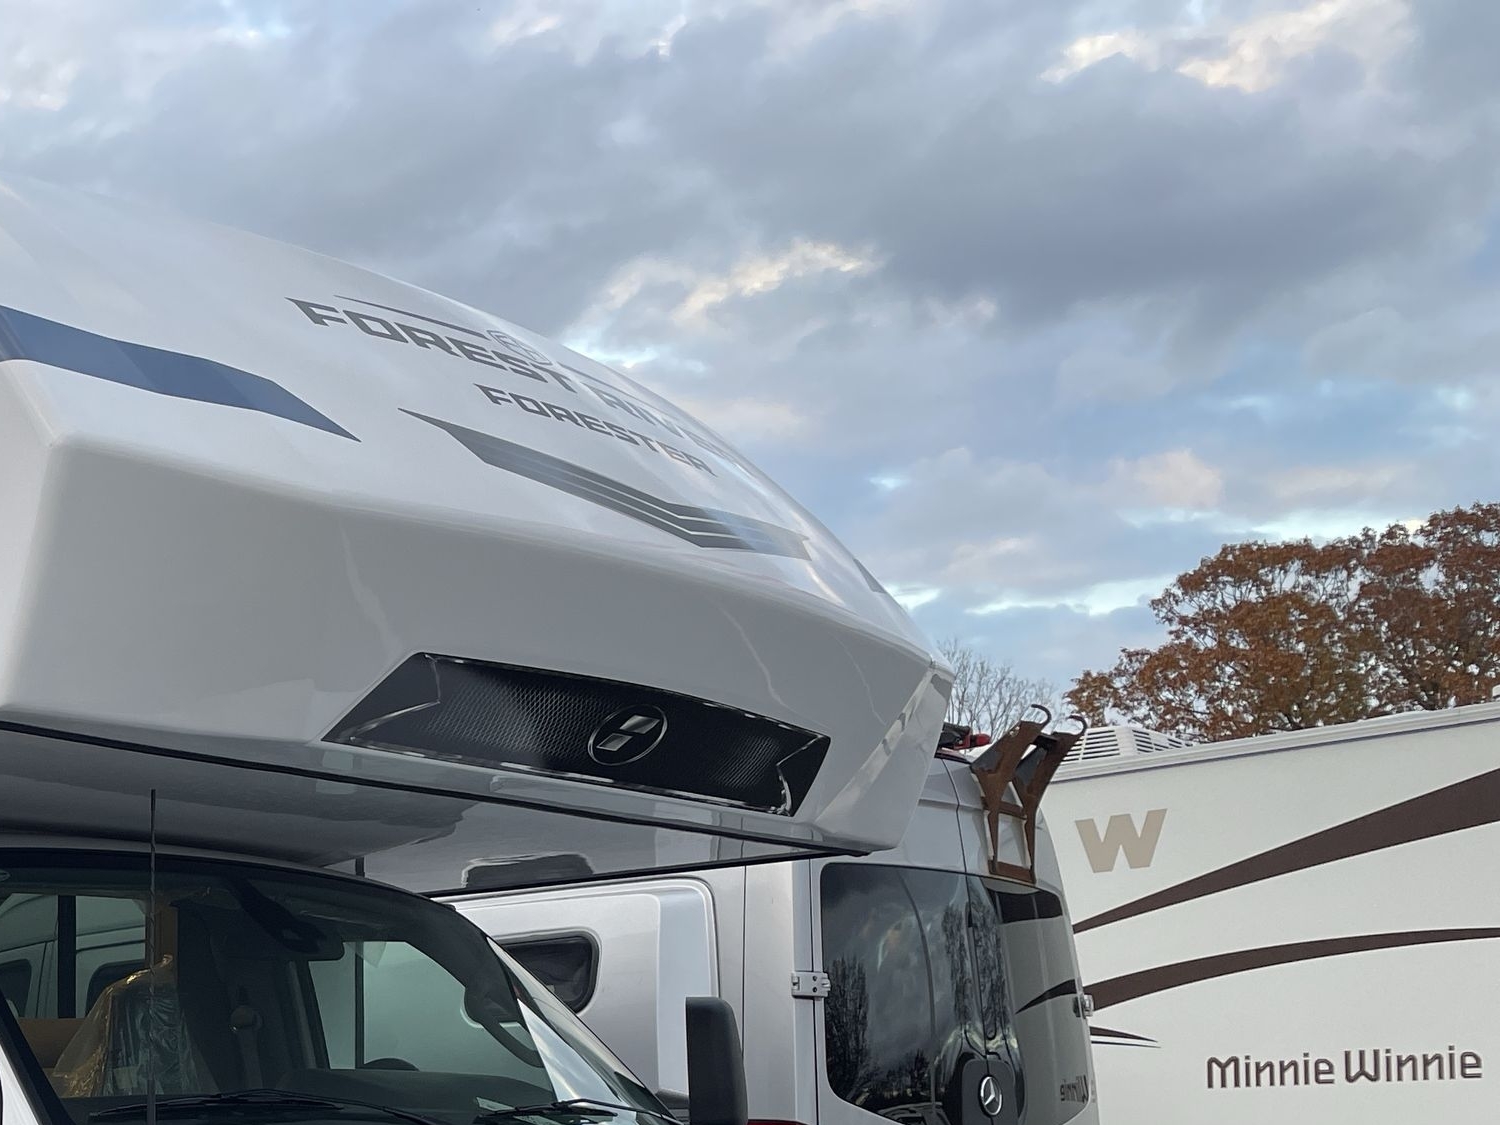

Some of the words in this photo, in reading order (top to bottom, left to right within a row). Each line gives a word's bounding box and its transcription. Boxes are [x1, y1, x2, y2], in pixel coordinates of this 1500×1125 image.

[285, 297, 578, 394] FOREST
[475, 383, 718, 478] FORESTER
[1074, 808, 1167, 874] W
[1206, 1052, 1335, 1089] Minnie
[1344, 1045, 1483, 1083] Winnie
